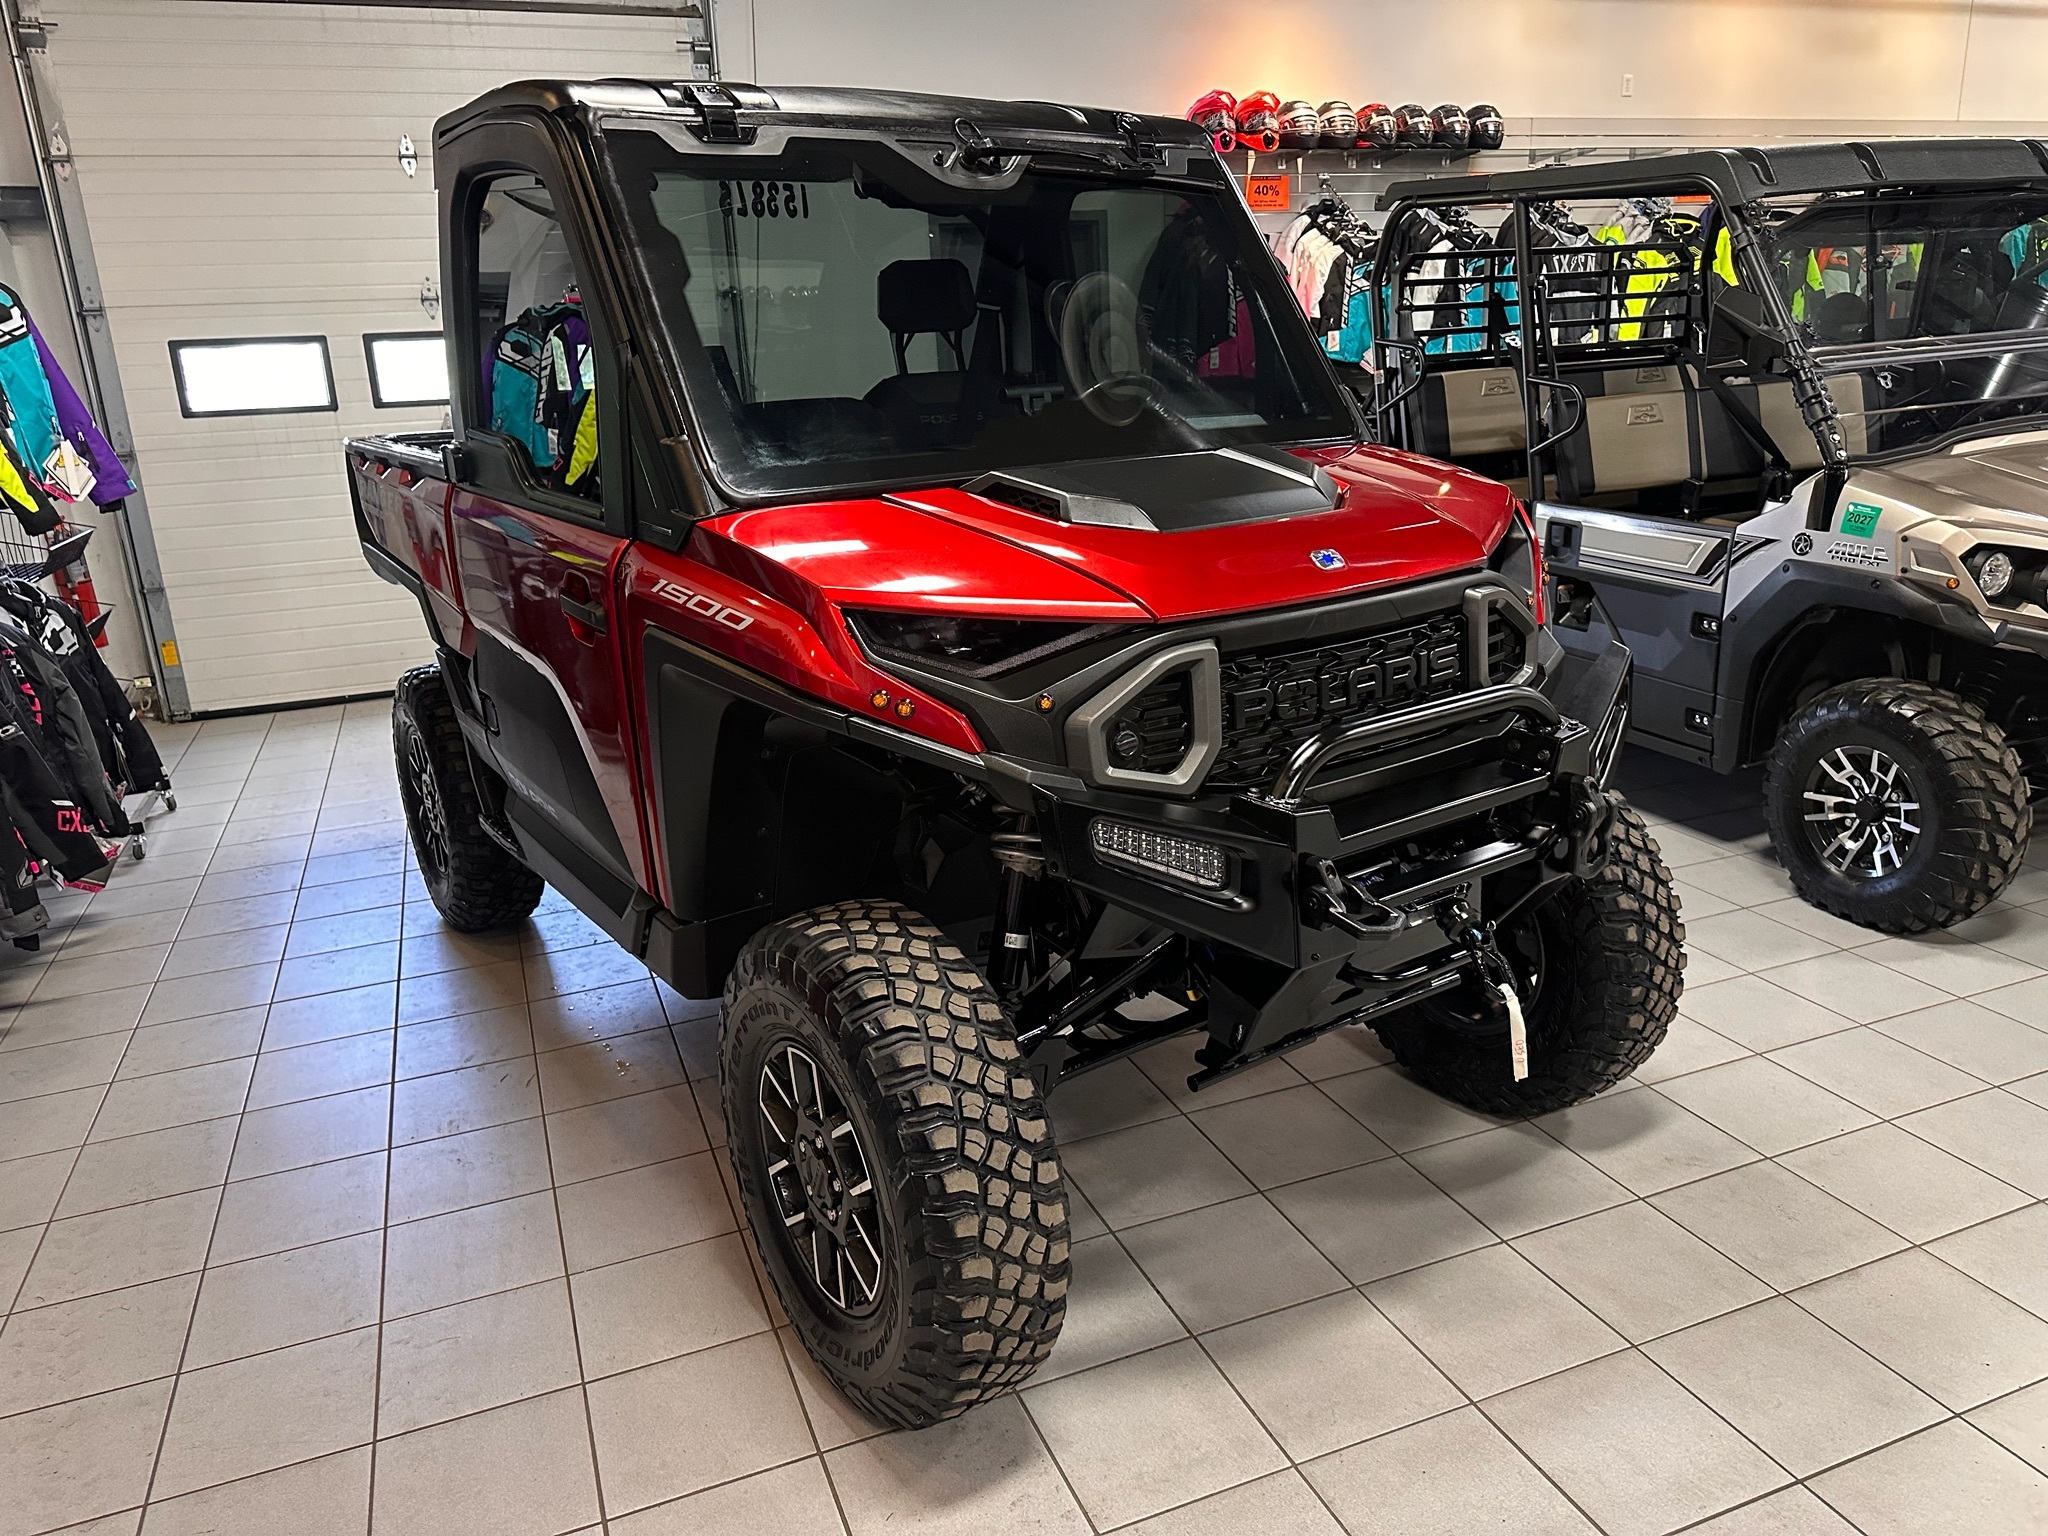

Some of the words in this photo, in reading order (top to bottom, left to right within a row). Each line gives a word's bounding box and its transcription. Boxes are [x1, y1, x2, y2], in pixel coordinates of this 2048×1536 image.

[1254, 185, 1280, 197] 40%
[1847, 512, 1874, 526] 2027
[1826, 541, 1889, 562] MULE
[651, 579, 754, 630] 1500
[1233, 643, 1460, 730] POLARIS
